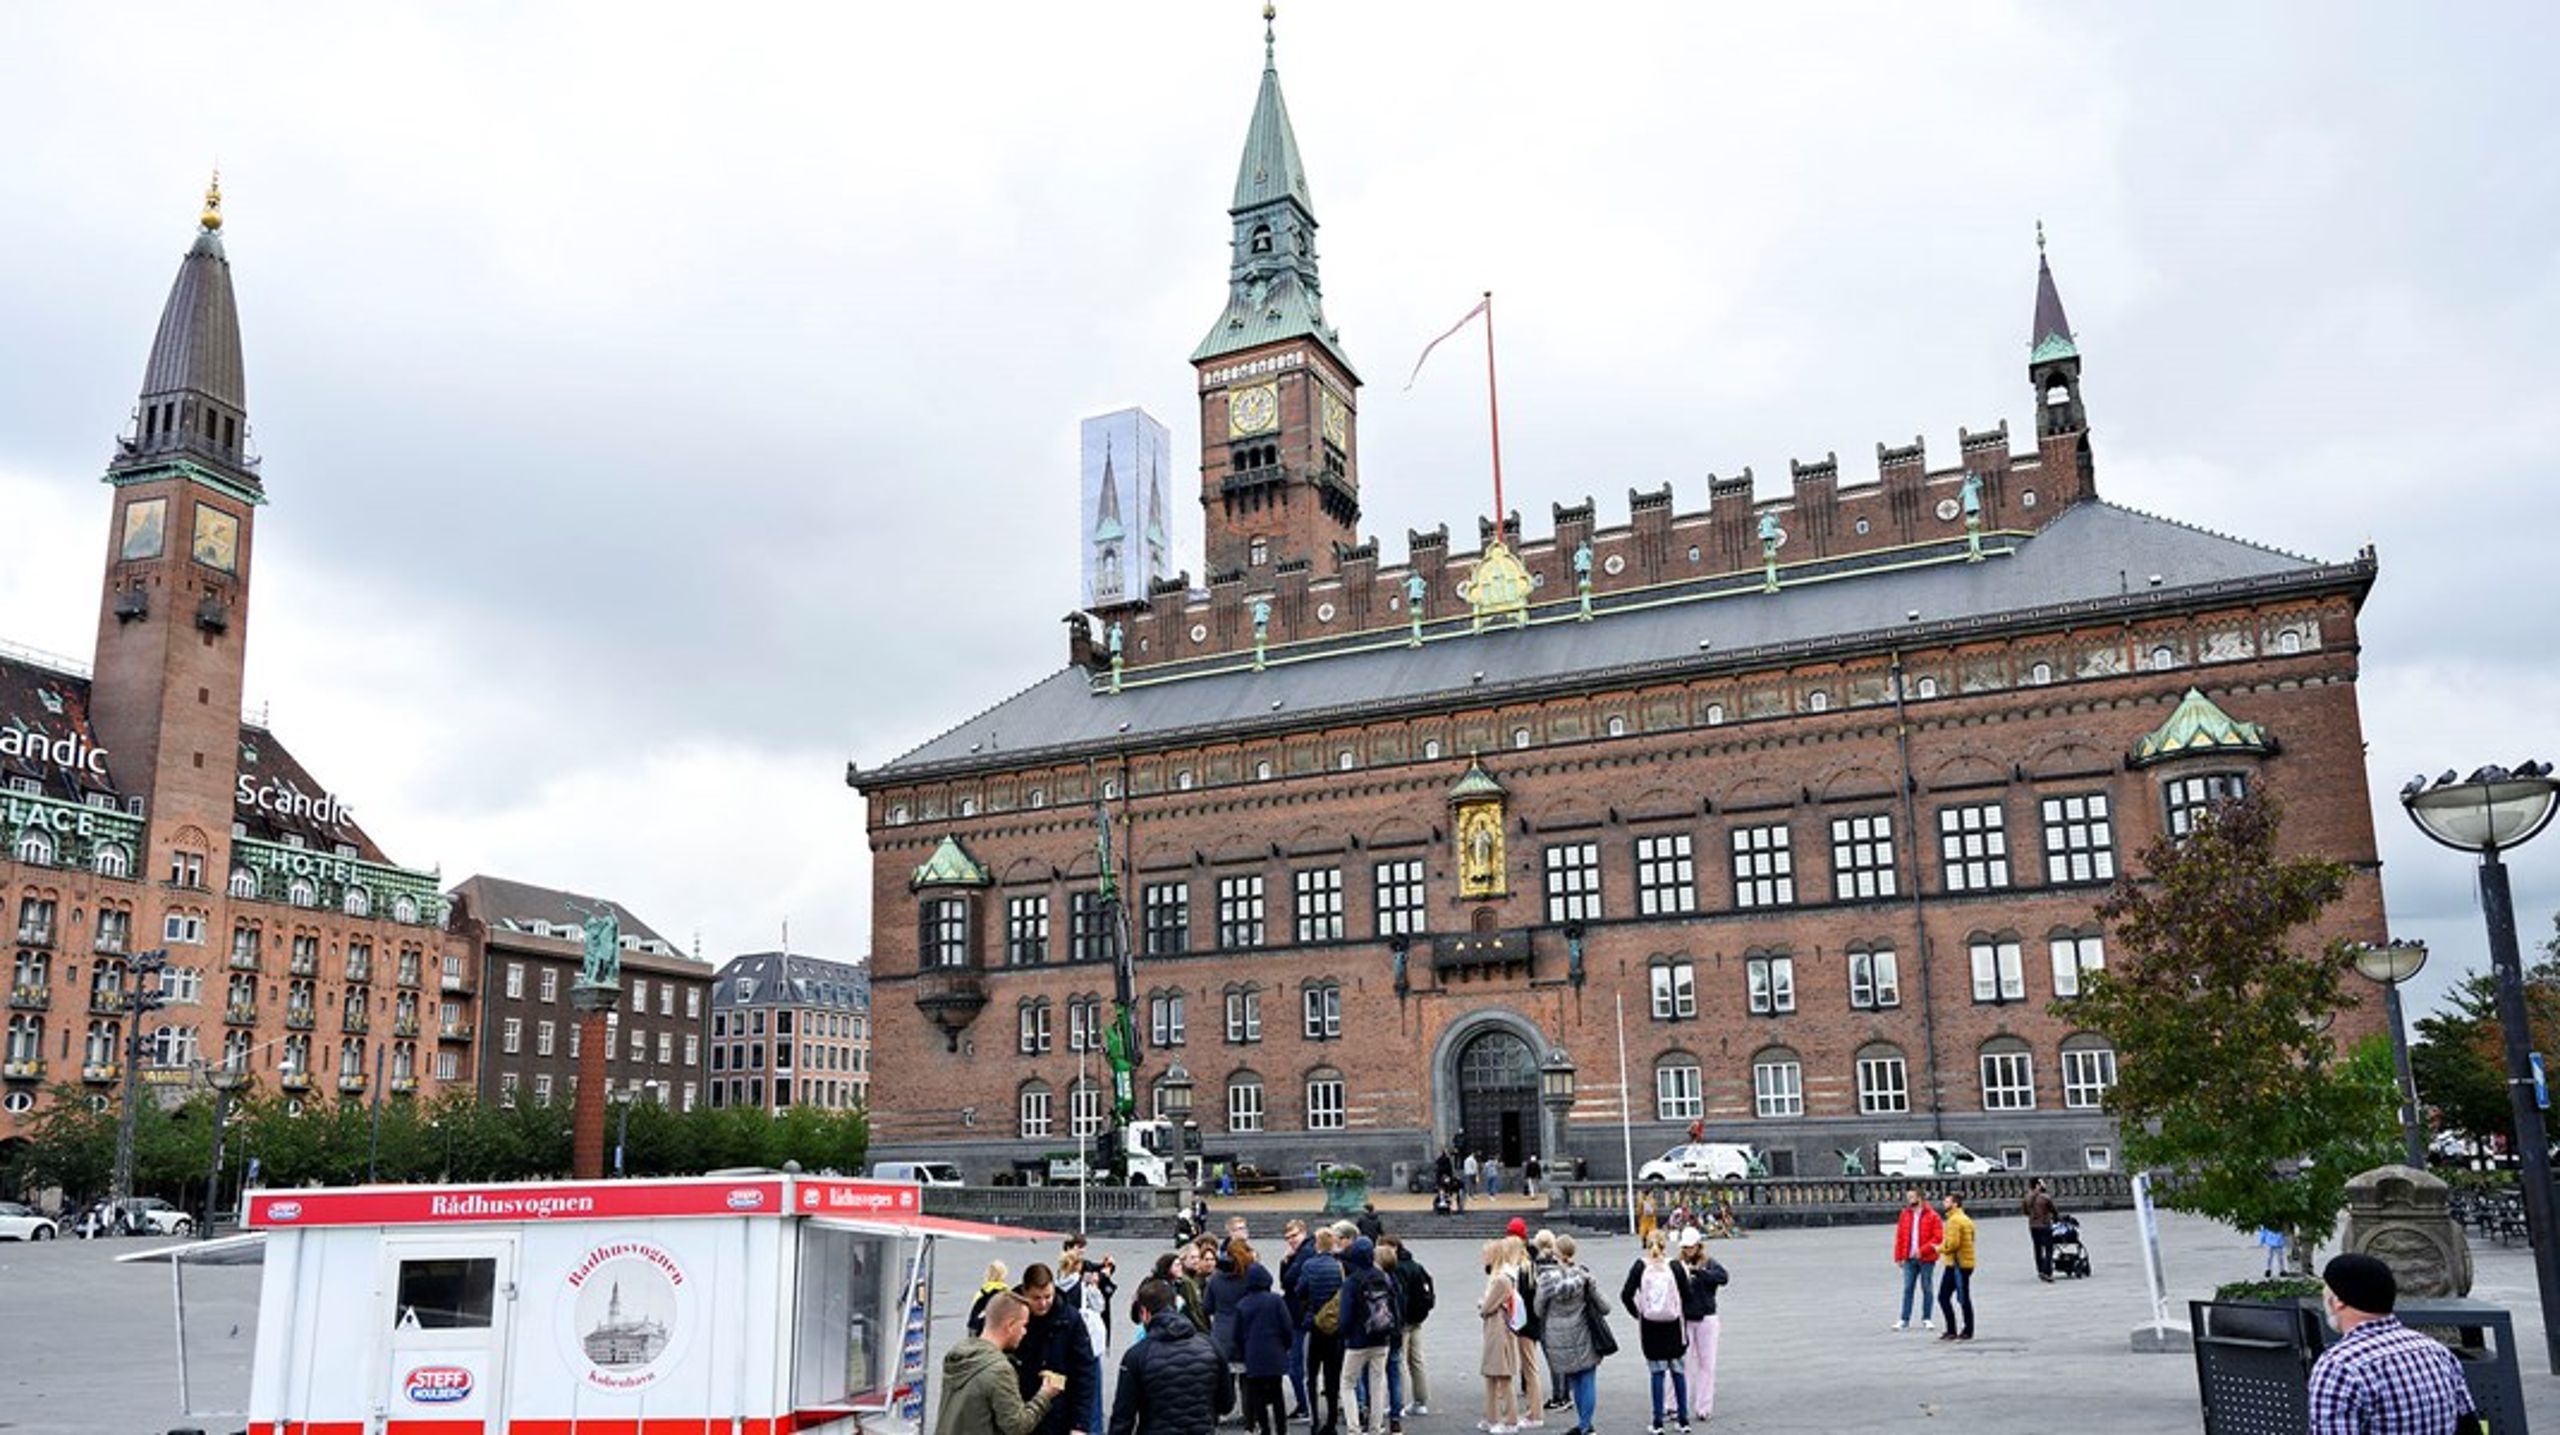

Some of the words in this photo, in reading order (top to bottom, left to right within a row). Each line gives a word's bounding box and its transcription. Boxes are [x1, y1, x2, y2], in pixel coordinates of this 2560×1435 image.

[236, 774, 353, 828] Scandic
[270, 848, 360, 886] HOTEL
[431, 1194, 593, 1218] Rådhusvognen
[415, 1372, 463, 1388] STEFF
